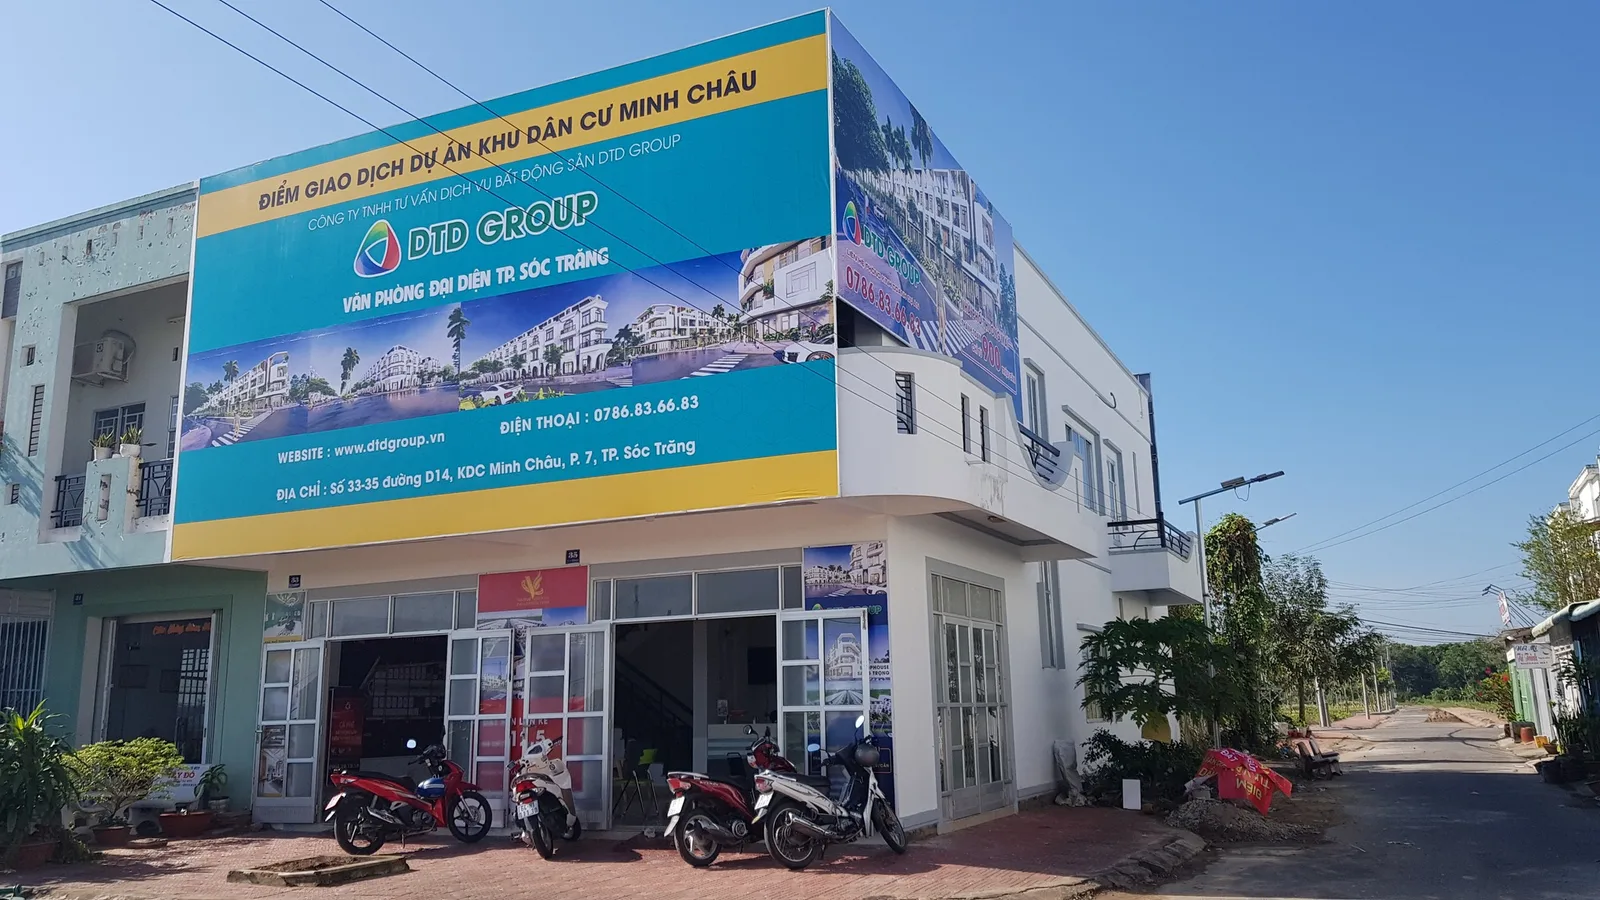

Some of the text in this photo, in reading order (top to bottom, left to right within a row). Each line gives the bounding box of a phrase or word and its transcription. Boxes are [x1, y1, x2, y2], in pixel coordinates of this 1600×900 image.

[258, 70, 757, 211] ĐIỂM GIAO DỊCH DỰ ÁN KHU DÂN CƯ MINH CHÂU
[308, 211, 344, 231] CÔNG
[348, 208, 360, 221] TY
[362, 200, 392, 219] TNHH
[394, 194, 409, 210] TƯ
[411, 187, 437, 207] VẤN
[440, 181, 471, 202] DỊCH
[495, 168, 518, 188] BẤT
[521, 161, 564, 182] ĐỘNG
[567, 152, 595, 172] SẢN
[598, 147, 625, 165] DTD
[629, 133, 682, 158] GROUP
[408, 190, 598, 261] DTD GROUP
[862, 227, 921, 286] DTD GROUP
[342, 247, 609, 313] VĂN PHÒNG ĐẠI DIỆN TP. SÓC TRĂNG
[846, 265, 921, 337] 0786.83.66.83
[981, 333, 1001, 372] 900
[277, 447, 324, 464] WEBSITE
[334, 432, 445, 457] www.dtdgroup.vn
[500, 416, 532, 436] ĐIỆN
[536, 411, 580, 429] THOẠI
[594, 395, 699, 422] 0786.83.66.83
[276, 487, 296, 504] ĐỊA
[299, 479, 320, 499] CHỈ
[330, 478, 345, 495] Số
[347, 477, 380, 493] 33-35
[382, 473, 422, 491] đường
[425, 468, 453, 484] D14,
[457, 464, 486, 480] KDC
[489, 460, 520, 476] Minh
[525, 456, 566, 472] Châu,
[570, 452, 580, 466] P.
[585, 450, 597, 466] 7,
[601, 448, 620, 462] TP.
[623, 443, 650, 460] Sóc
[654, 439, 696, 456] Trăng
